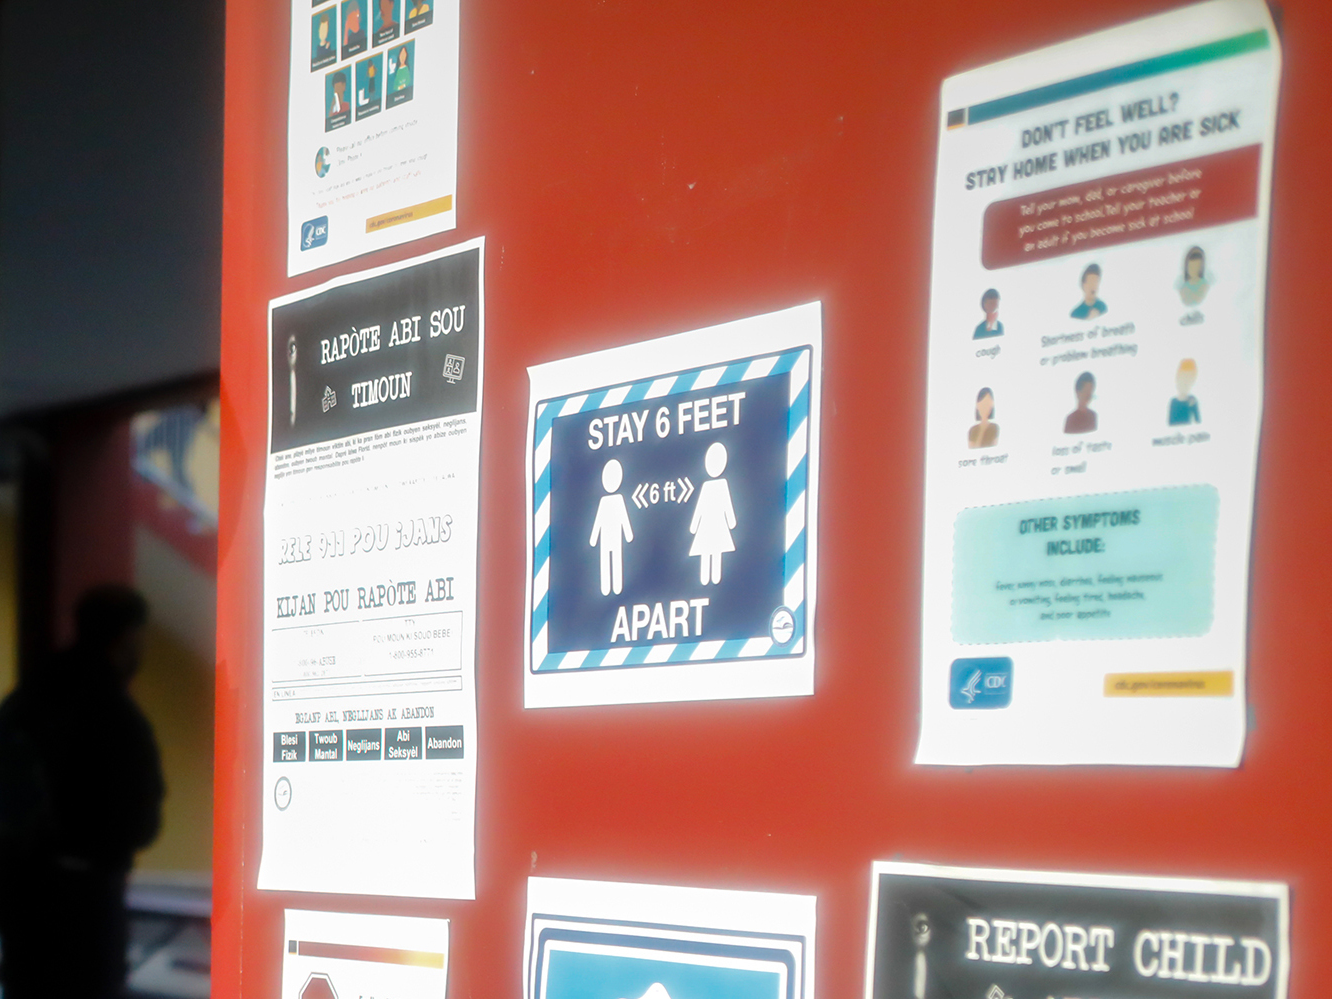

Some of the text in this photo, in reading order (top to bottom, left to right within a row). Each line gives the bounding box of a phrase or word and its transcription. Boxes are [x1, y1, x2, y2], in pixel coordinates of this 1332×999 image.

[1022, 92, 1180, 148] DON'T FEEL WELL?
[965, 109, 1242, 191] STAY HOME WHEN YOU ARE SICK
[1020, 203, 1035, 215] Tell
[1037, 201, 1056, 215] your
[1106, 188, 1118, 196] or
[1121, 178, 1165, 194] caregiver
[1167, 168, 1202, 184] before
[1019, 225, 1035, 237] you
[1036, 219, 1059, 231] come
[1061, 215, 1072, 225] to
[1123, 201, 1145, 216] your
[1148, 191, 1186, 207] teacher
[1189, 189, 1202, 199] or
[1024, 242, 1035, 252] an
[1037, 236, 1059, 249] adult
[1061, 231, 1070, 243] if
[1071, 232, 1088, 245] you
[1089, 224, 1125, 238] become
[1127, 217, 1146, 231] sick
[321, 305, 466, 364] RAPÒTE ABI SOU
[1041, 322, 1136, 348] Shortness of breath
[976, 345, 1001, 359] cough
[1052, 349, 1088, 367] problem
[1091, 343, 1138, 360] breathing
[351, 372, 412, 408] TIMOUN
[588, 393, 746, 450] STAY 6 FEET
[980, 454, 1008, 466] throat
[1052, 445, 1070, 456] loss
[1072, 441, 1083, 454] of
[1051, 466, 1062, 475] or
[650, 481, 676, 503] 6 ft
[1019, 510, 1141, 535] OTHER SYMPTOMS
[278, 535, 312, 565] RELE
[319, 530, 345, 558] 911
[350, 523, 389, 555] POU
[1047, 538, 1105, 556] INCLUDE:
[277, 577, 454, 618] KIJAN POU RAPÒTE ABI
[611, 598, 709, 642] APART
[281, 734, 298, 746] Blesi
[314, 734, 338, 744] Twoub
[348, 740, 380, 753] Neglijans
[397, 730, 410, 742] Abi
[428, 737, 462, 749] Abandon
[281, 750, 297, 760] Fizik
[315, 749, 337, 760] Mantal
[966, 917, 1272, 986] REPORT CHILD
